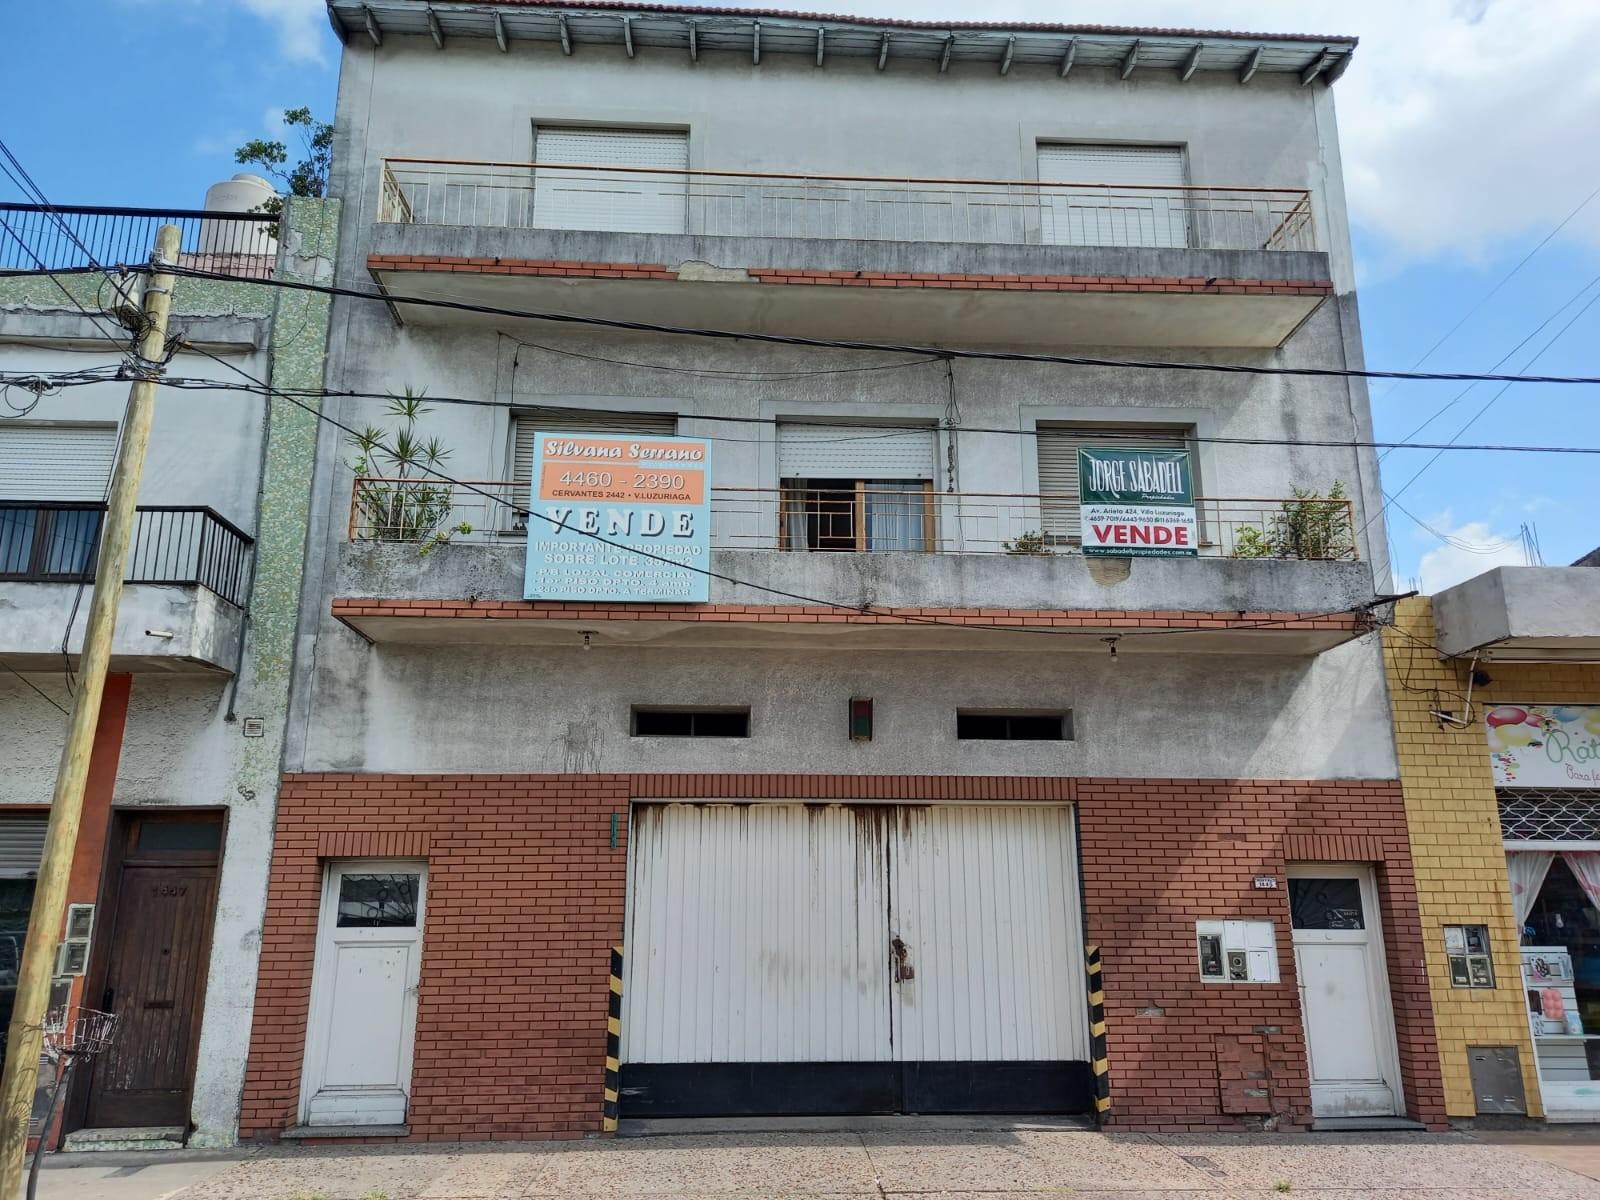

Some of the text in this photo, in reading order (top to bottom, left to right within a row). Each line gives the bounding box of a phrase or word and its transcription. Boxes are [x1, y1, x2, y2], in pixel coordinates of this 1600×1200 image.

[546, 440, 703, 460] Silvana Serrano
[559, 471, 612, 487] 4460
[633, 473, 685, 490] 2390
[1089, 455, 1185, 499] JORGE SABADELL
[552, 490, 604, 498] CERVANTES
[606, 491, 625, 499] 2442
[546, 505, 694, 539] VENDE
[1092, 525, 1188, 545] VENDE
[535, 540, 703, 556] IMPORTANTE PROPIEDAD
[544, 553, 594, 565] SOBRE
[601, 554, 639, 566] LOTE
